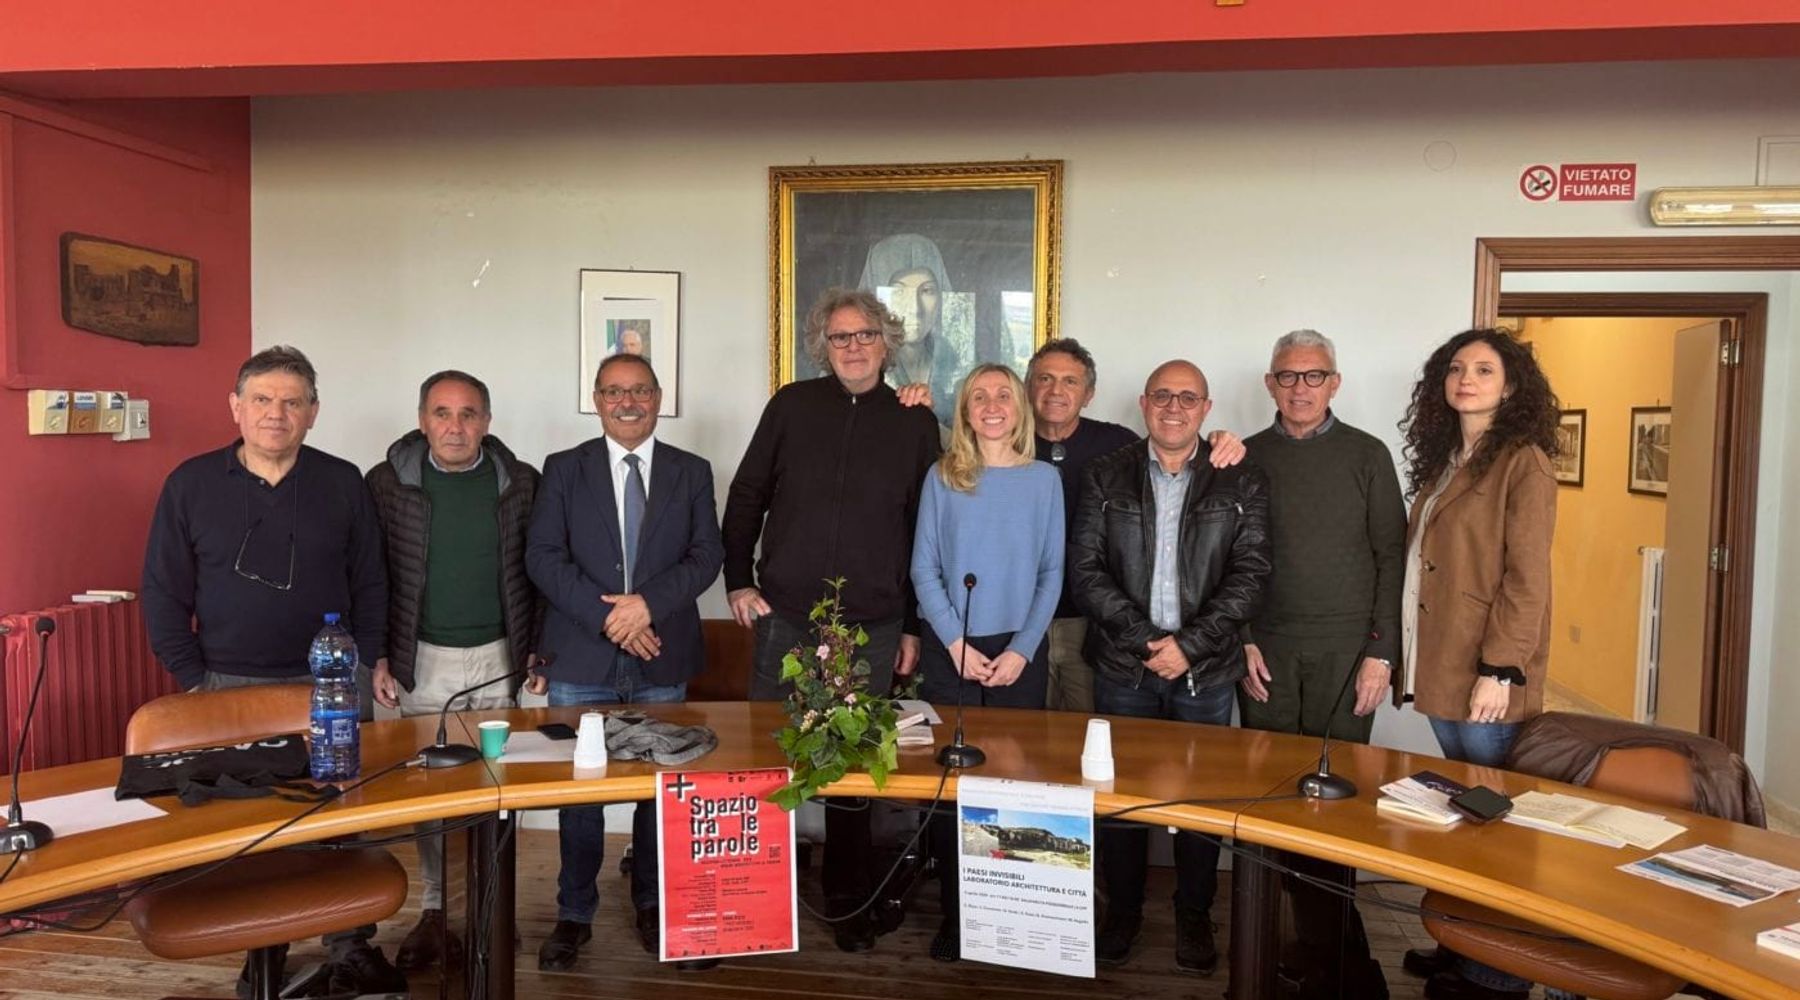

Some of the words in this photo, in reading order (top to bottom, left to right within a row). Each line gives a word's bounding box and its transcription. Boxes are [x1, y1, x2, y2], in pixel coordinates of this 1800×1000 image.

[1565, 169, 1632, 181] VIETATO
[1563, 184, 1632, 197] FUMARE
[690, 792, 758, 819] Spazio
[690, 816, 718, 836] tra
[740, 812, 758, 832] le
[691, 832, 759, 861] parole
[967, 867, 988, 877] PAESI
[989, 870, 1025, 881] INVISIBILI
[963, 876, 1010, 887] LABORATORIO
[1011, 881, 1061, 894] ARCHITETTURA
